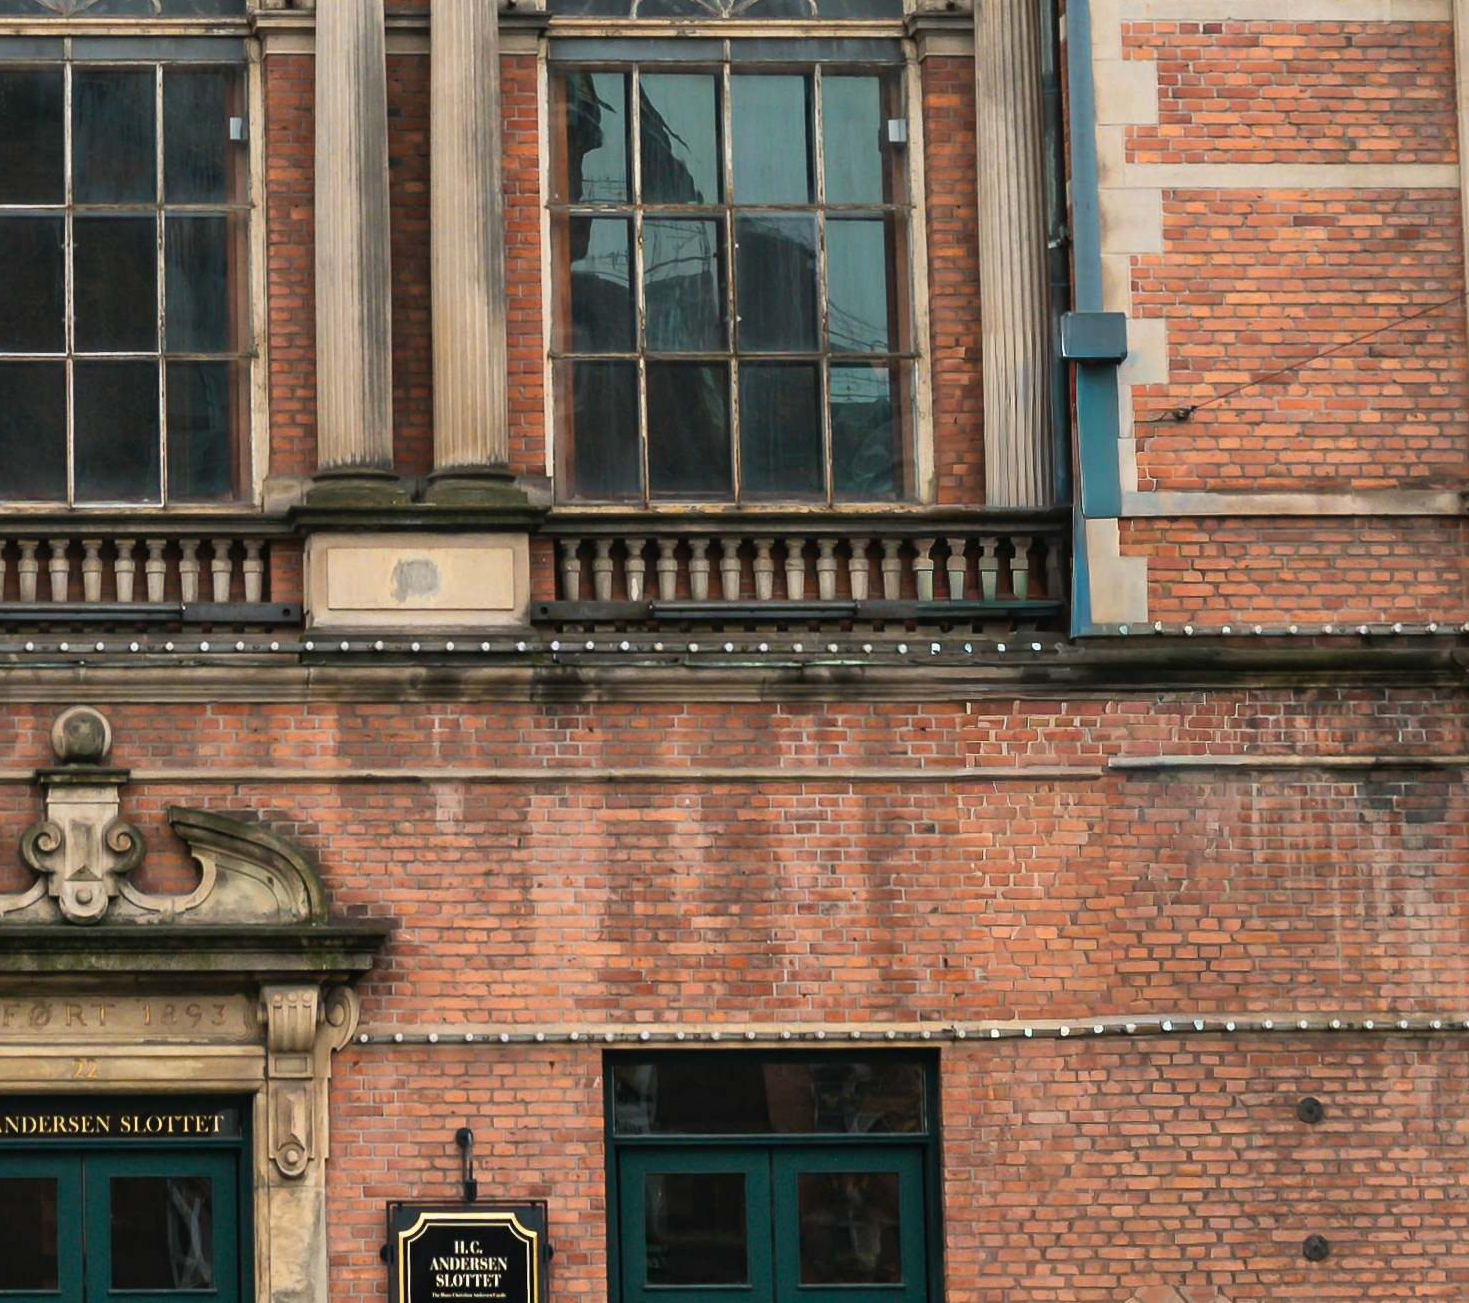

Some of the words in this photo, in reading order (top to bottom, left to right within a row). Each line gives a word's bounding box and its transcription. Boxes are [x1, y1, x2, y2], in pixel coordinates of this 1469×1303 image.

[142, 1001, 227, 1027] 1893
[70, 1057, 98, 1079] 22
[120, 1114, 225, 1134] SLOTTET
[454, 1240, 483, 1255] H.C.
[430, 1256, 508, 1271] ANDERSEN
[435, 1273, 502, 1288] SLOTTET
